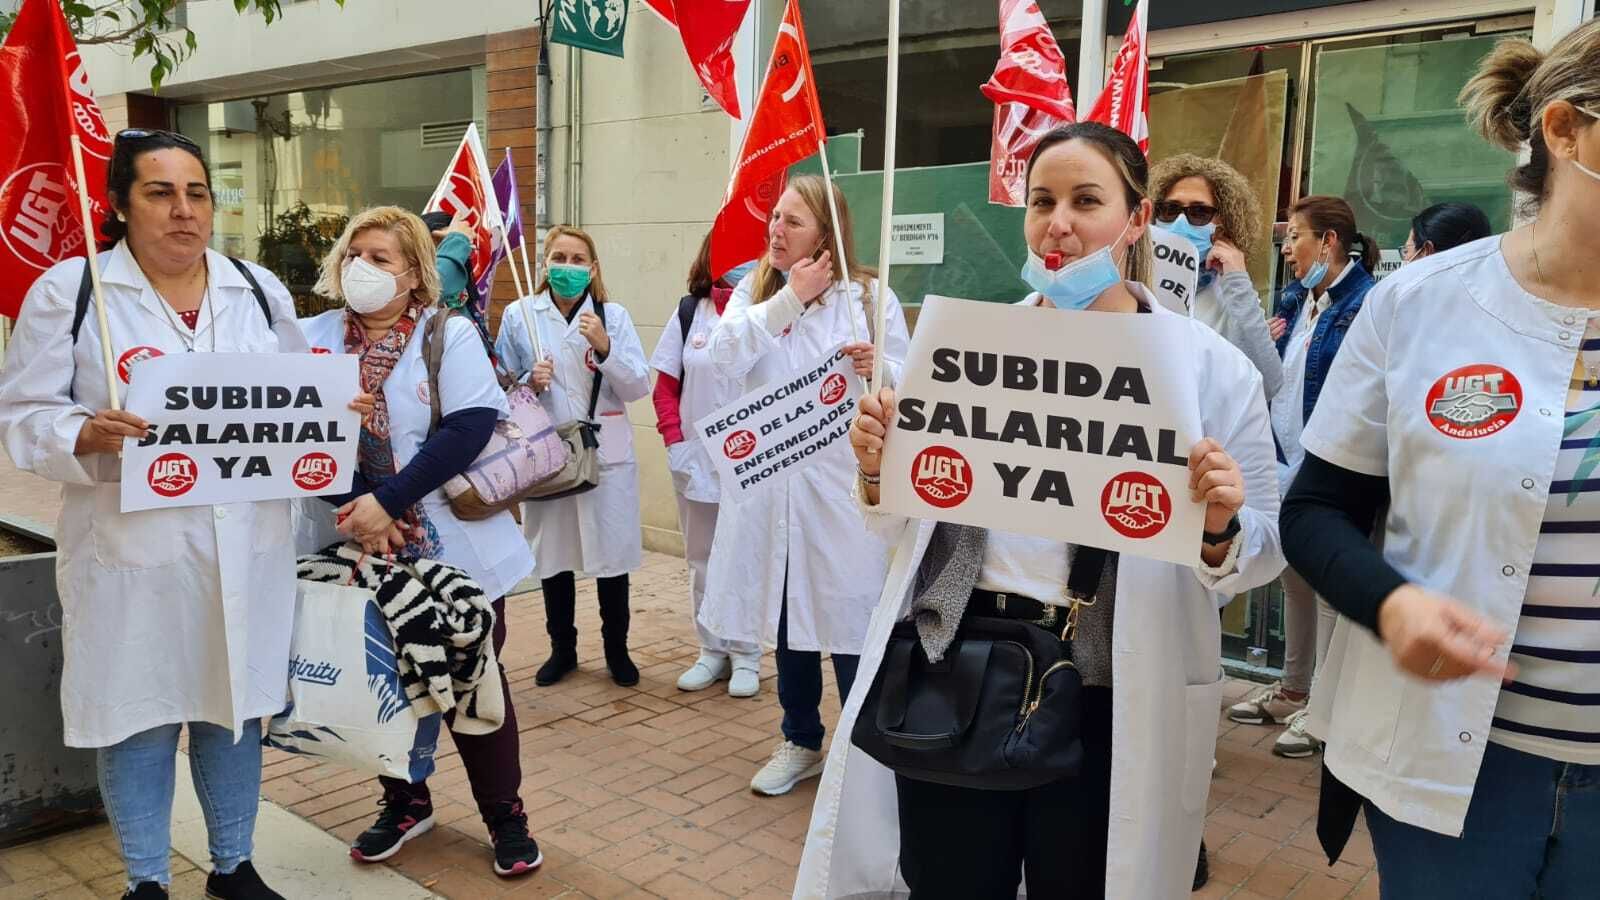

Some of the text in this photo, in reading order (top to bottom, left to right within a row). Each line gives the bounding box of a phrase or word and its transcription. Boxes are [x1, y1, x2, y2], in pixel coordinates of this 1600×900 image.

[10, 170, 67, 254] UGT
[1160, 278, 1186, 298] DE
[821, 375, 841, 396] UGT
[931, 347, 1151, 405] SUBIDA
[1443, 373, 1504, 398] UGT
[164, 386, 323, 410] SUBIDA
[704, 349, 846, 438] RECONOCIMIENTO
[759, 400, 815, 437] DE LAS
[1439, 419, 1507, 438] Andalucia
[137, 421, 347, 447] SALARIAL
[726, 431, 751, 453] UGT
[733, 398, 855, 476] ENFERMEDADES
[897, 398, 1189, 466] SALARIAL
[153, 459, 191, 477] UGT
[213, 455, 272, 479] YA
[300, 458, 333, 473] UGT
[917, 453, 965, 483] UGT
[993, 462, 1075, 507] YA
[1110, 480, 1164, 513] UGT
